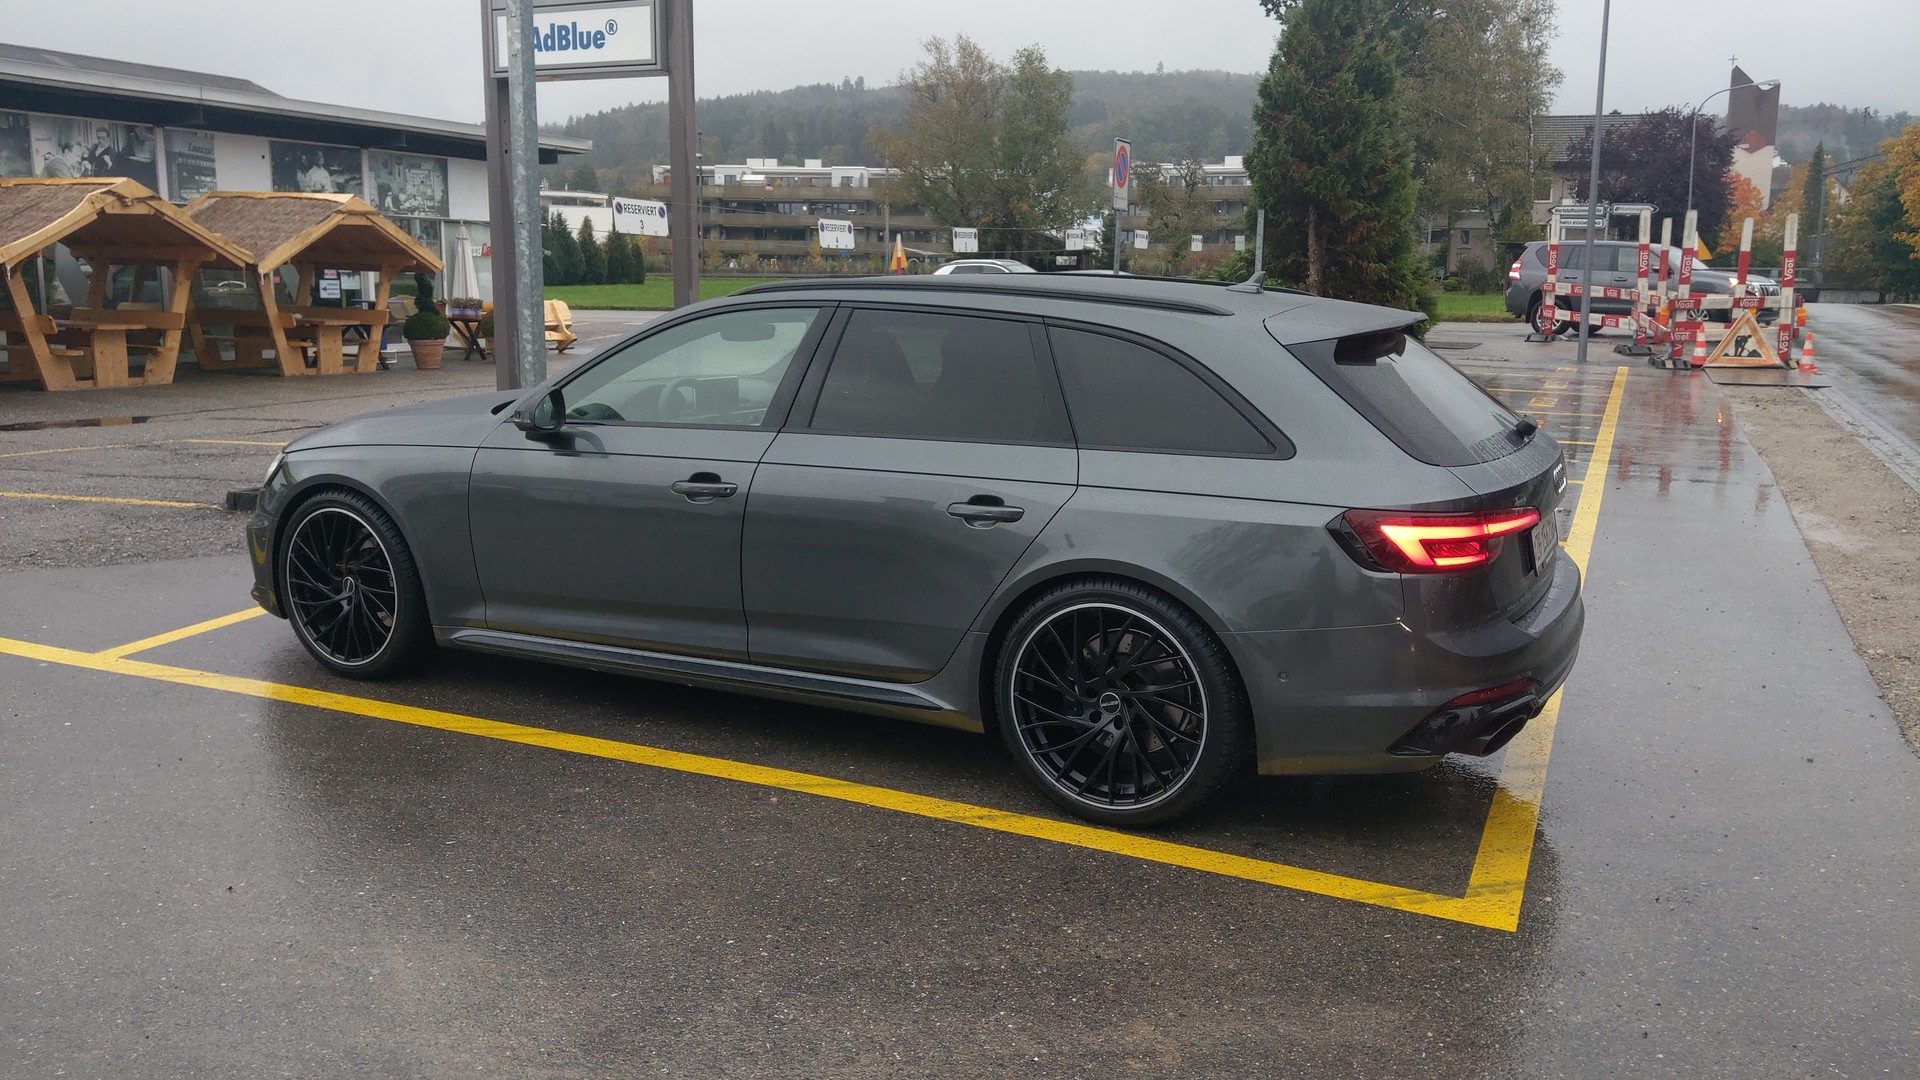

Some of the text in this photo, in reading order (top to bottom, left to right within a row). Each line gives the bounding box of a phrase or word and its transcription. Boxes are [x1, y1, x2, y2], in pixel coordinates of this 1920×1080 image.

[623, 203, 657, 216] RESERVIERT
[639, 219, 644, 230] 3
[825, 223, 847, 233] RESERVIERT
